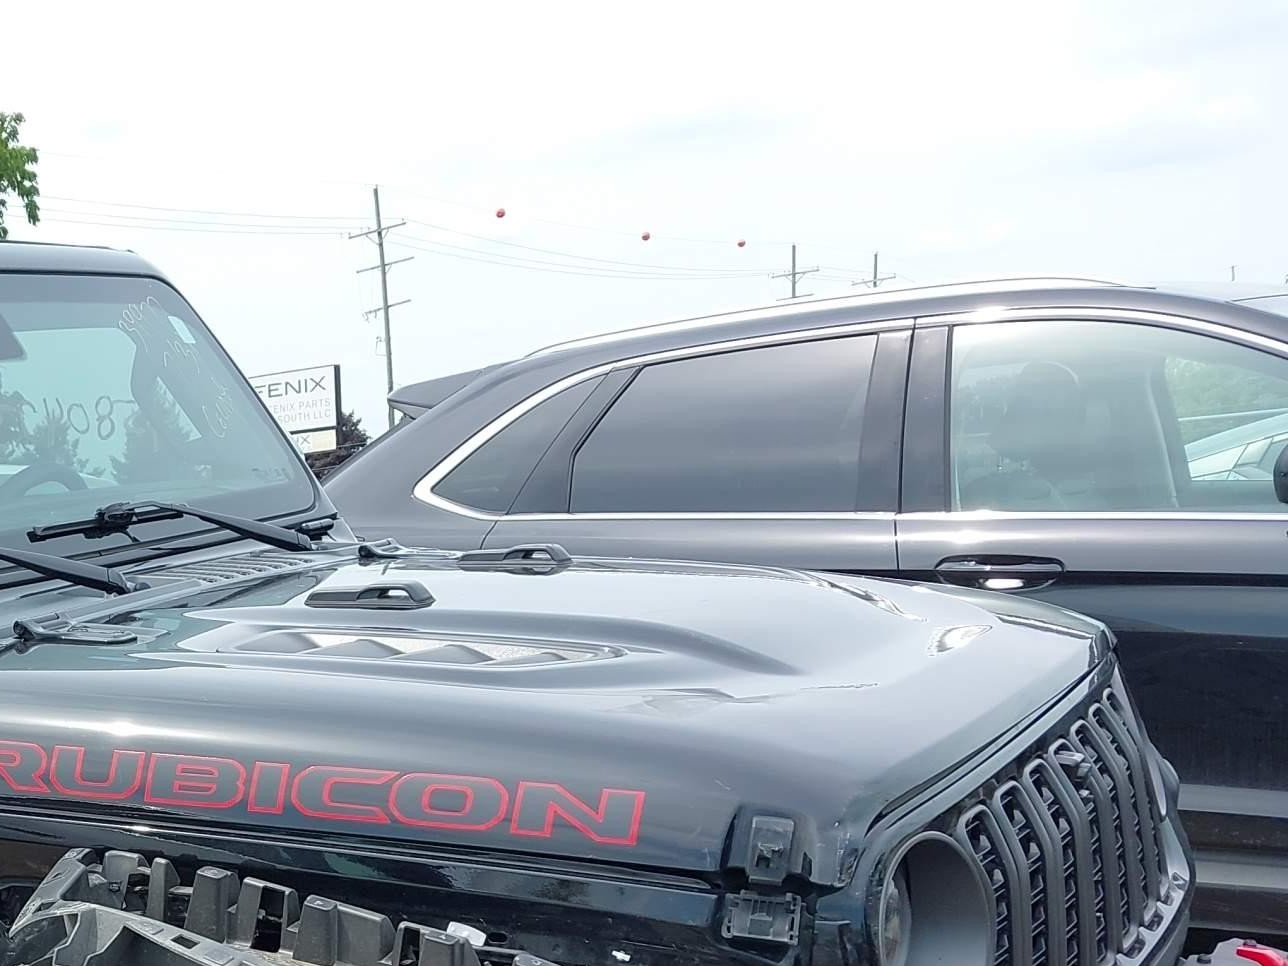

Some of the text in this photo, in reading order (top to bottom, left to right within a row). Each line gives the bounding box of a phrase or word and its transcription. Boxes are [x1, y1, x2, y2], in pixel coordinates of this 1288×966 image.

[269, 398, 330, 414] ENIX PARTS
[277, 409, 330, 424] SOUTH LLC
